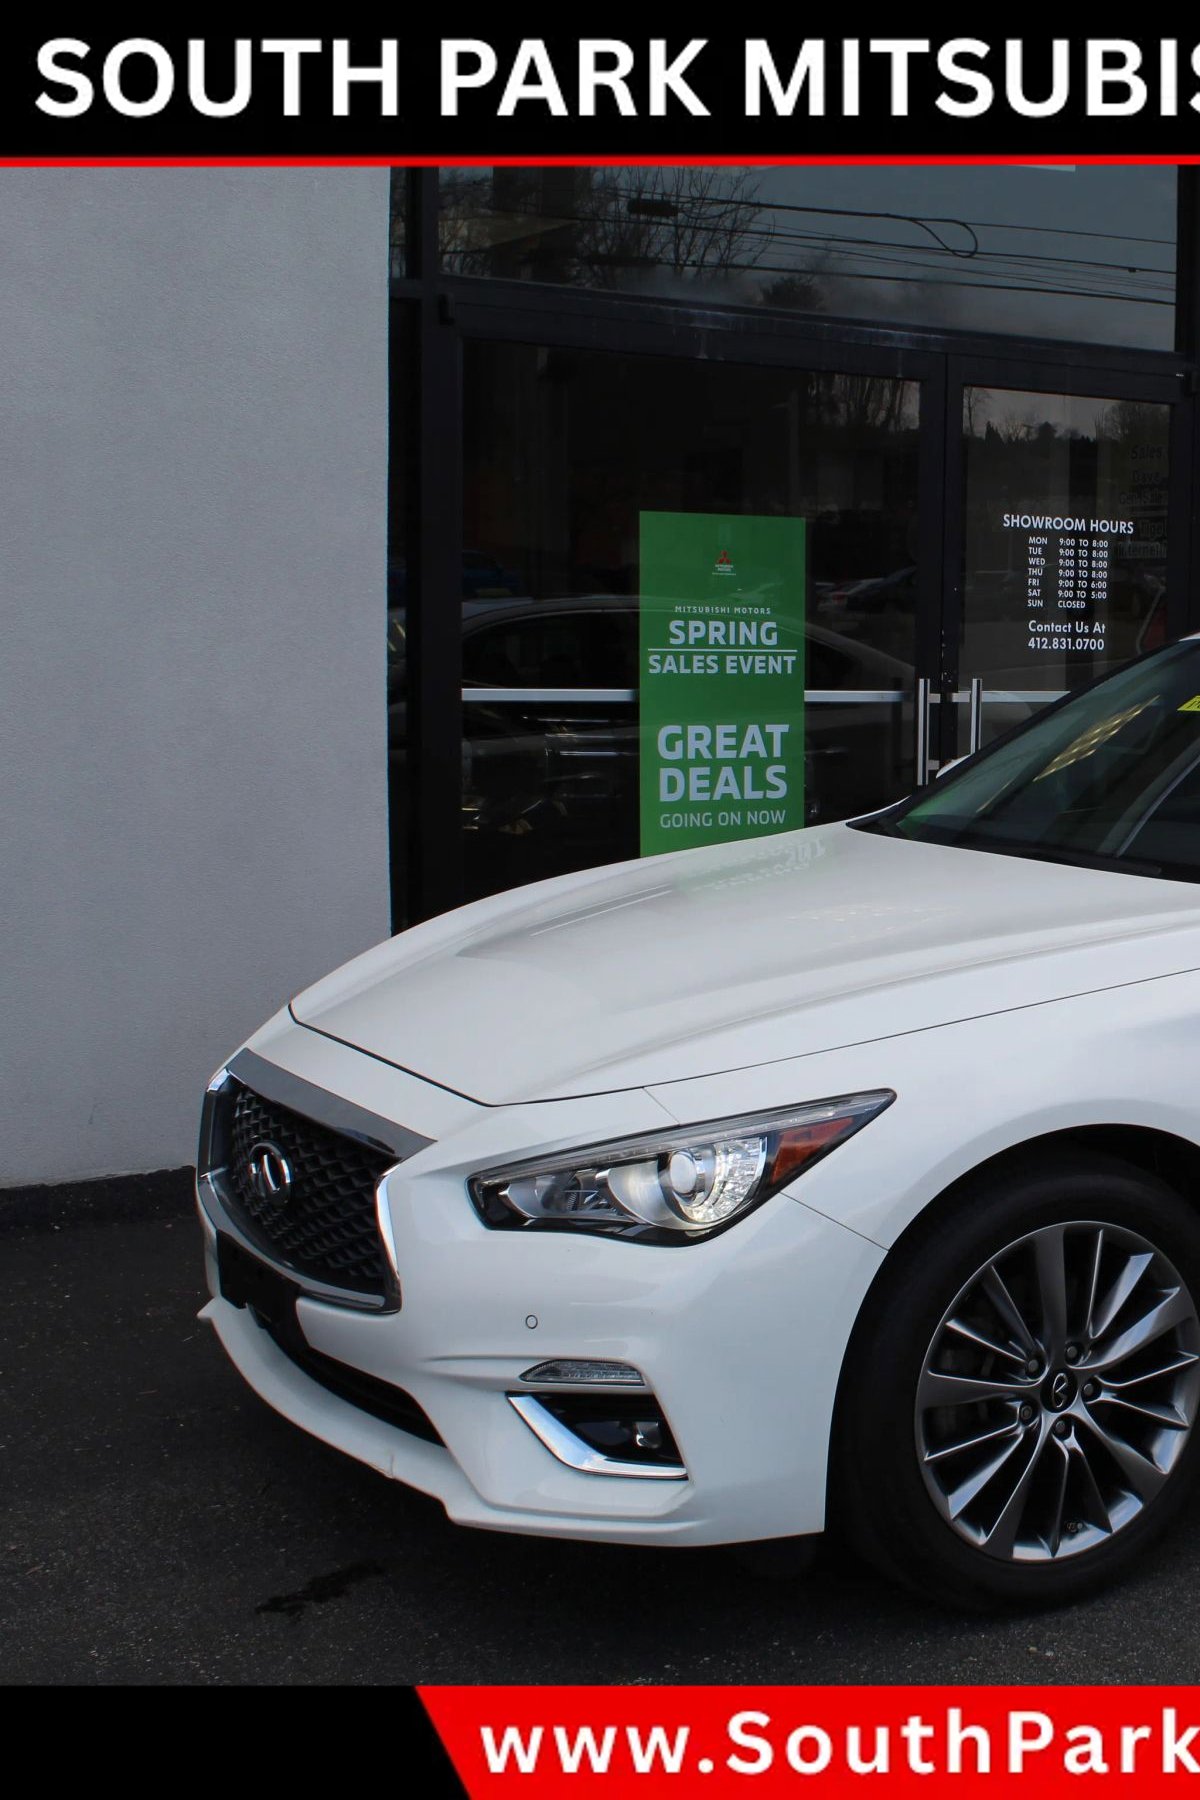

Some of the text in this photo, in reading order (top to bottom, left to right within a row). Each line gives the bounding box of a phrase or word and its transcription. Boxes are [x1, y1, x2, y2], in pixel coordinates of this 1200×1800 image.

[1003, 514, 1086, 532] SHOWROOM
[1090, 519, 1134, 534] HOURS
[1028, 536, 1108, 548] MON 9:00 TO 8:00
[1028, 547, 1042, 555] TUE
[1059, 548, 1075, 557] 9:00
[1078, 549, 1088, 557] TO
[1092, 550, 1108, 558] 8:00
[1028, 557, 1108, 568] WED 9:00 TO 8:00
[1028, 568, 1108, 579] THU 9:00 TO 8:00
[1028, 578, 1107, 589] FRI 9:00 TO 6:00
[1027, 589, 1107, 599] SAT 9:00 TO 5:00
[674, 606, 771, 615] MITSUBISHI MOTORS
[1027, 599, 1086, 609] SUN CLOSED
[669, 620, 778, 646] SPRING
[1028, 620, 1106, 634] Contact Us At
[1028, 637, 1105, 651] 412.831.0700
[648, 654, 797, 674] SALES EVENT
[657, 724, 789, 760] GREAT
[659, 764, 789, 802] DEALS
[660, 810, 787, 829] GOING ON NOW
